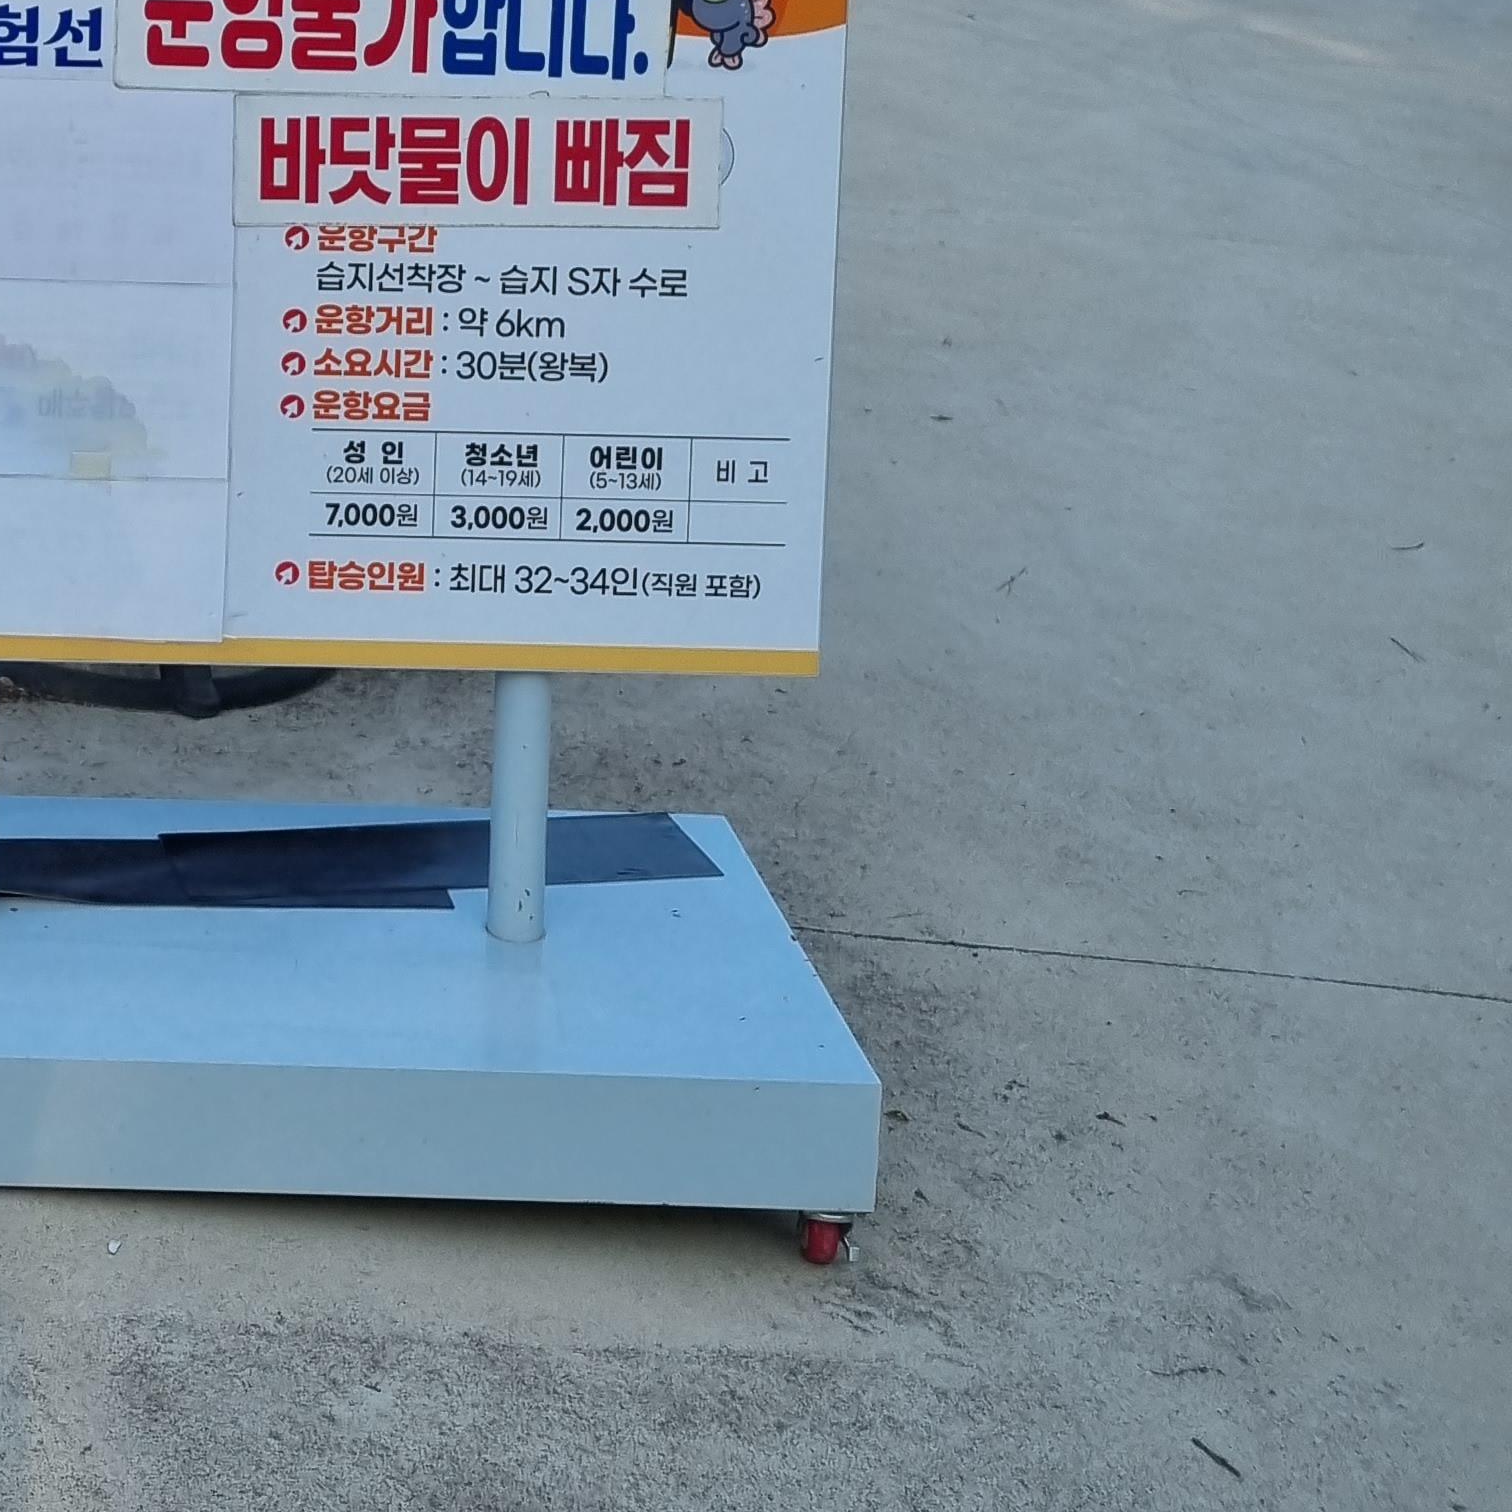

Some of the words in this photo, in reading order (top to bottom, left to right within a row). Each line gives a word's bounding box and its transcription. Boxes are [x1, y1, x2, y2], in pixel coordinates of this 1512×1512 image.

[259, 115, 530, 206] 바닷물이
[553, 117, 691, 208] 빠짐
[317, 225, 438, 253] 운항구간
[316, 260, 467, 294] 습지선착장
[499, 264, 558, 296] 습지
[567, 266, 622, 298] S자
[628, 267, 688, 299] 수로
[314, 304, 433, 336] 운항거리
[458, 307, 489, 338] 약
[495, 308, 566, 339] 6km
[313, 347, 434, 379] 소요시간
[455, 350, 609, 384] 30분(왕복)
[312, 390, 431, 422] 운항요금
[464, 442, 538, 468] 청소년
[589, 445, 663, 471] 어린이
[326, 465, 374, 485] (20세
[379, 466, 420, 486] 이상)
[460, 468, 541, 489] (14~19세)
[589, 471, 662, 492] (5~13세)
[325, 502, 418, 528] 7,000원
[450, 504, 548, 531] 3,000원
[575, 507, 674, 534] 2,000원
[308, 560, 425, 592] 탑승인원
[449, 562, 506, 594] 최대
[704, 574, 761, 600] 포함)
